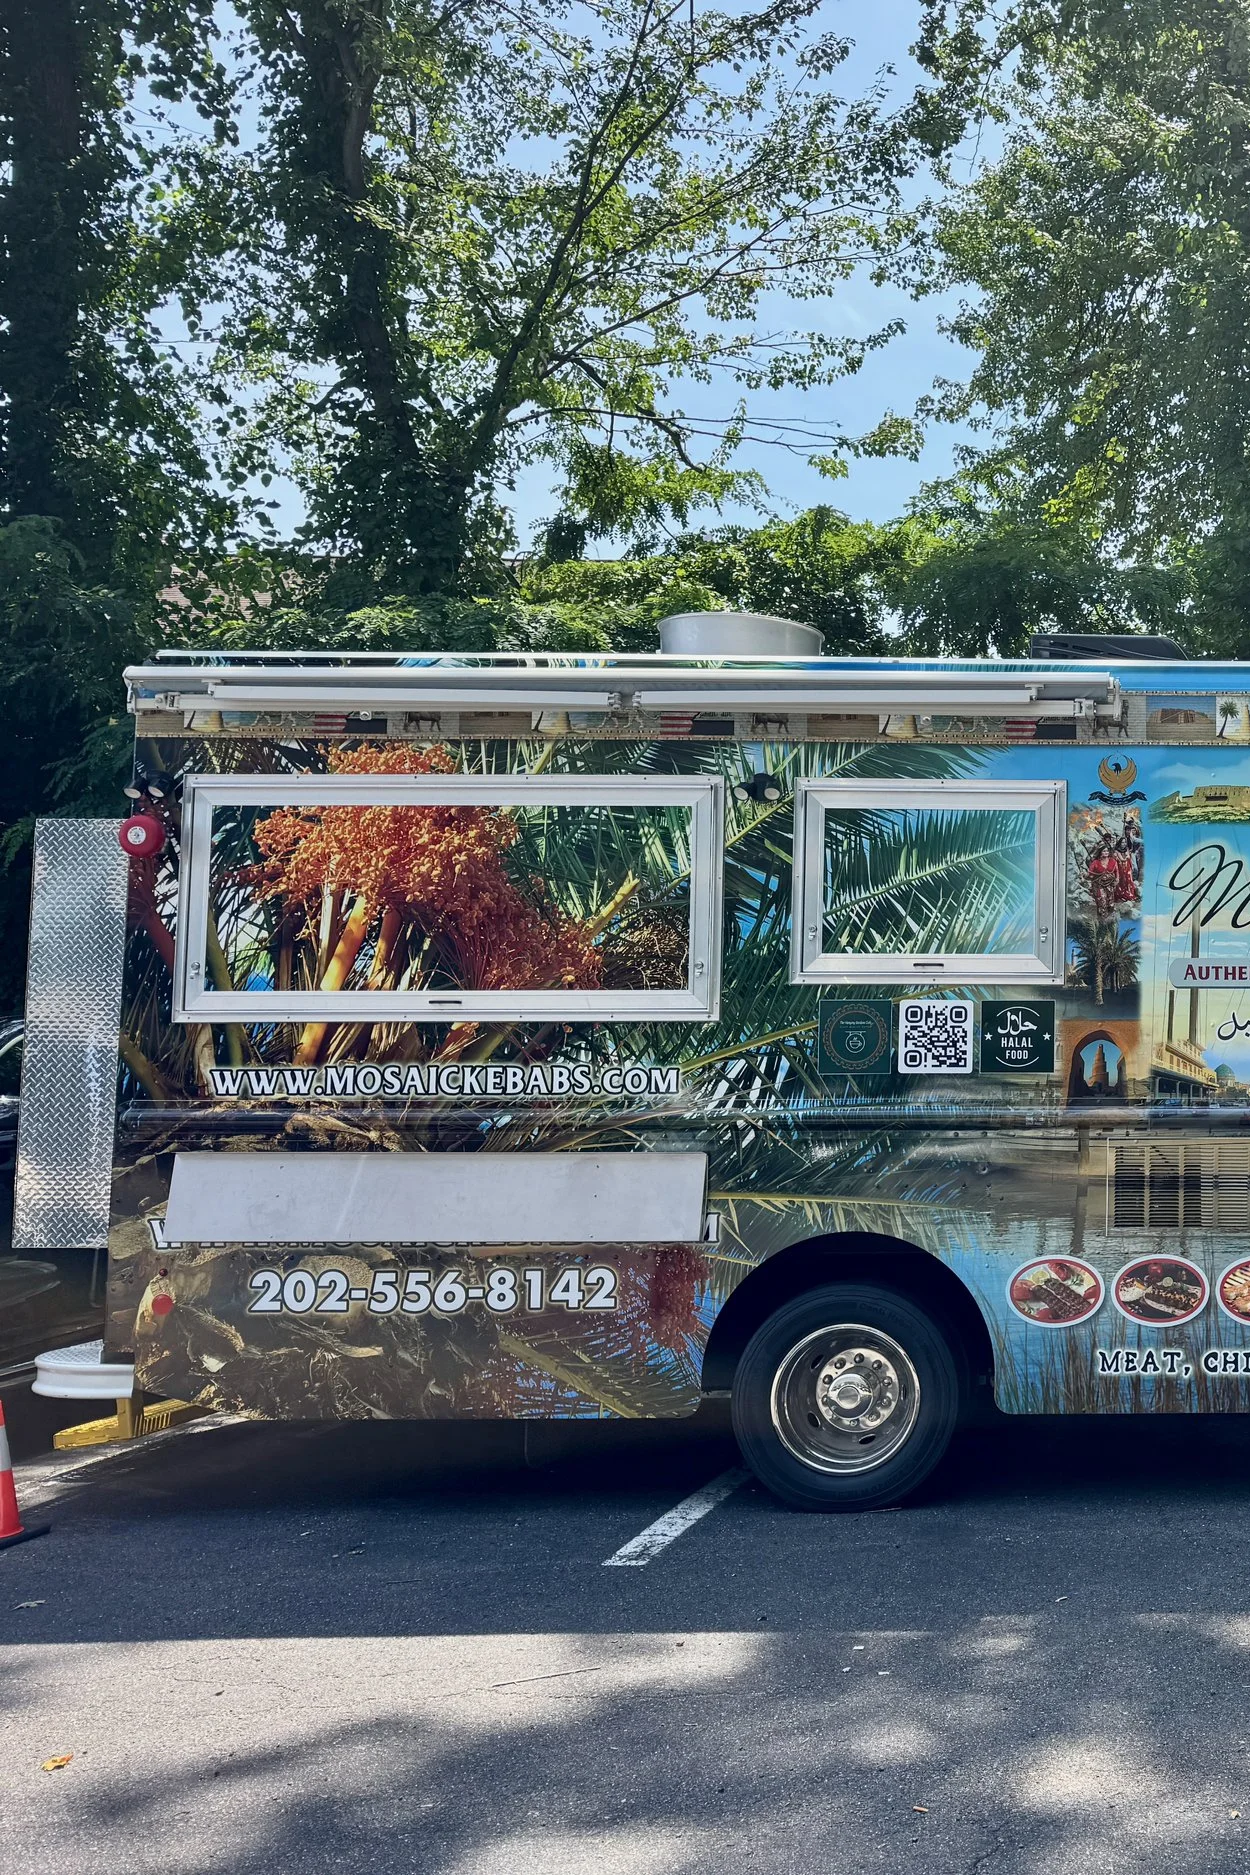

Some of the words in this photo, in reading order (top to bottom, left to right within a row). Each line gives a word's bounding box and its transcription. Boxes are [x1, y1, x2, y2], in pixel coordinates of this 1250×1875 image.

[997, 1010, 1038, 1036] حلال
[1001, 1036, 1034, 1048] HALAL
[1005, 1049, 1029, 1060] FOOD
[209, 1064, 681, 1097] WWW.MOSAICKEBABS.COM
[248, 1266, 618, 1314] 202-556-8142
[1098, 1349, 1191, 1377] MEAT,
